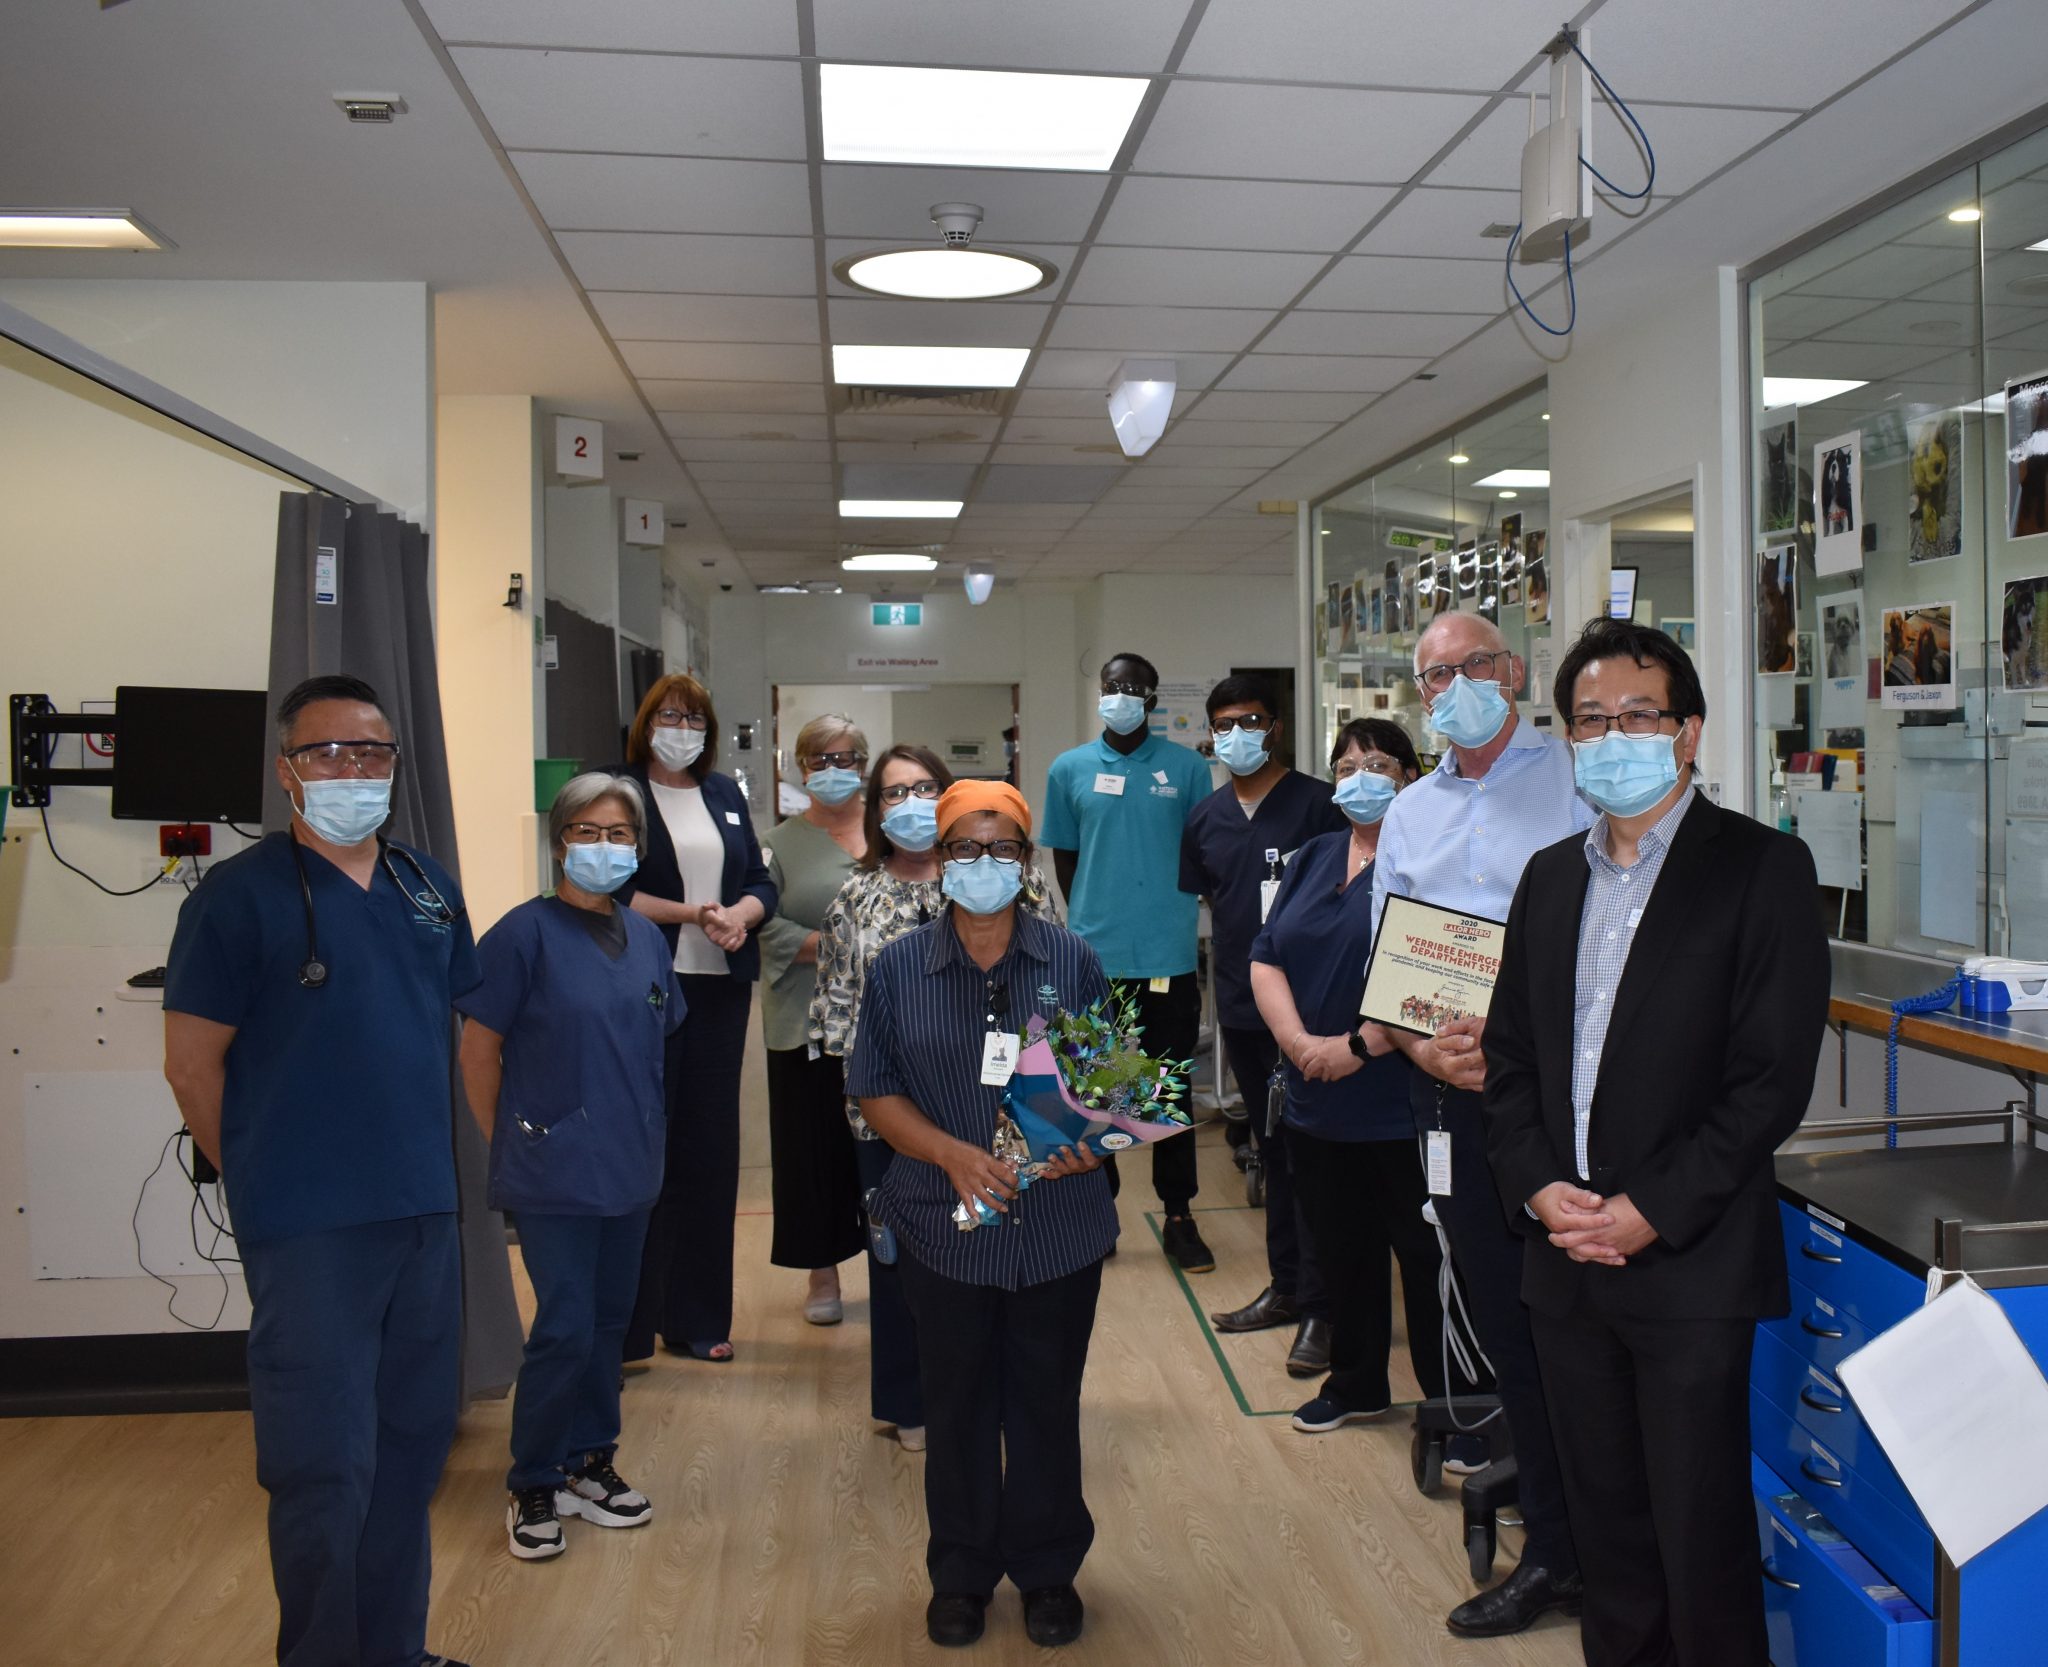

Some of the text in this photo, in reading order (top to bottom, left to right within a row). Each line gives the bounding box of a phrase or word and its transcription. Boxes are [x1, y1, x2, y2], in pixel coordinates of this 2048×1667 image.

[575, 436, 587, 458] 2
[641, 514, 648, 530] 1
[857, 658, 873, 666] Exit
[888, 658, 918, 667] Waiting
[919, 658, 939, 666] Area
[1893, 690, 1919, 702] Ferguson
[1460, 919, 1478, 928] 2020
[1445, 924, 1490, 937] LALOR HERO
[1453, 934, 1477, 942] AWARD
[1406, 935, 1456, 955] WERRIBEE
[1388, 952, 1413, 962] recognition
[1410, 945, 1477, 969] DEPARTMENT
